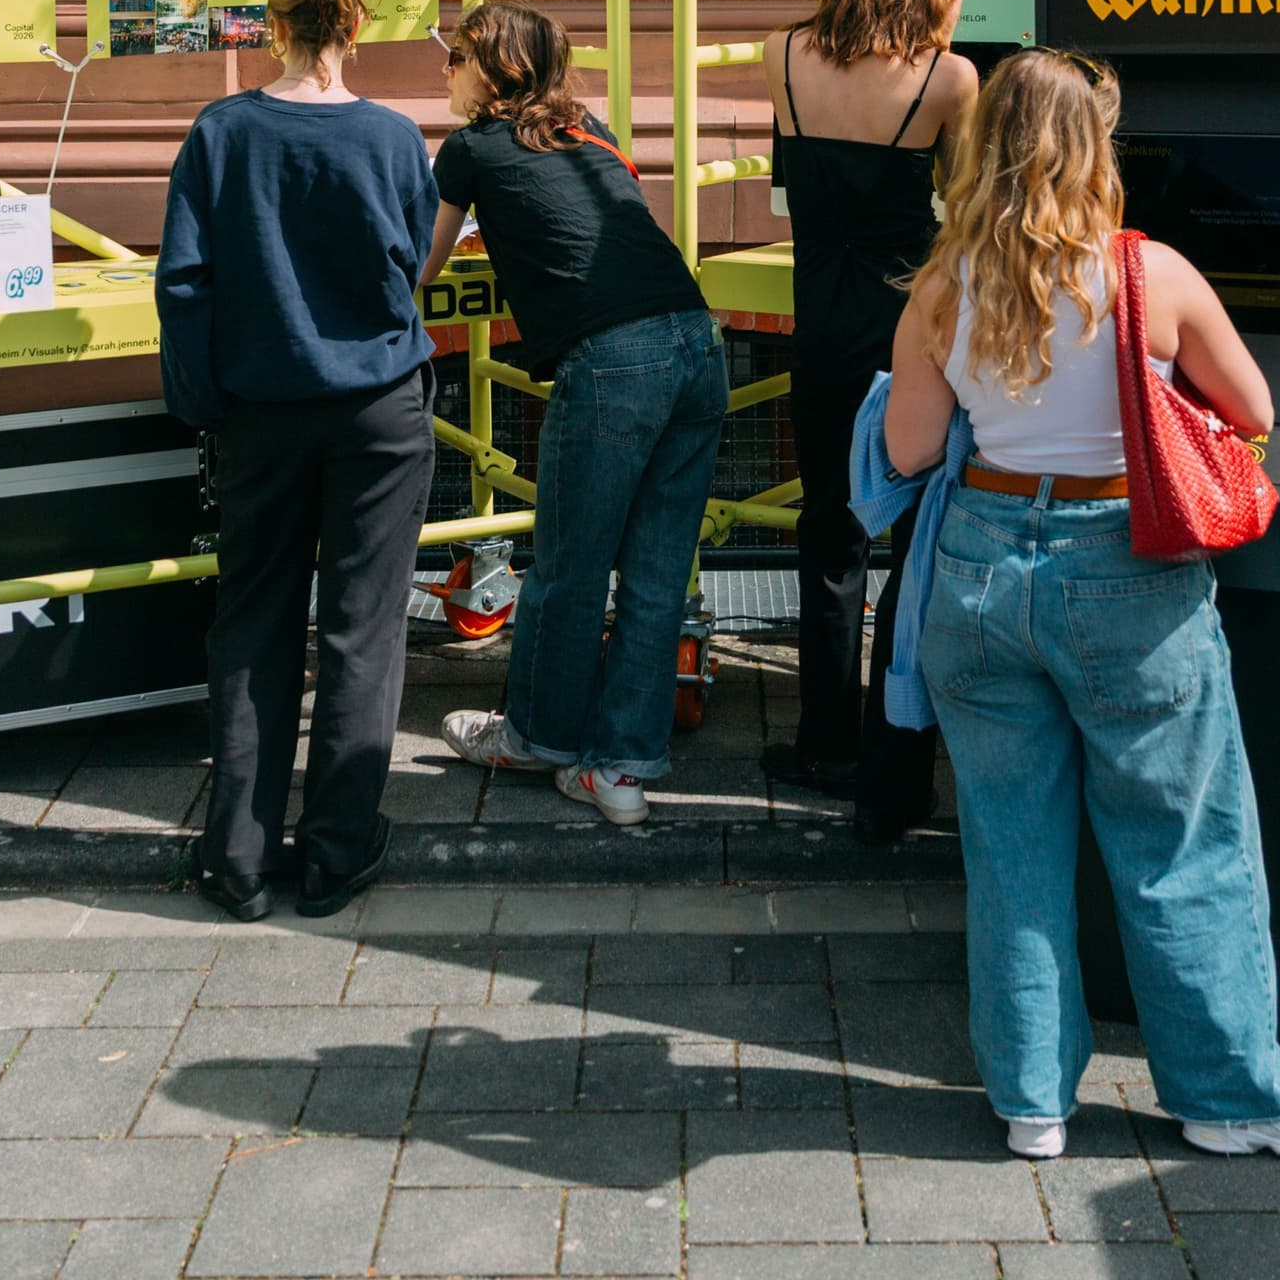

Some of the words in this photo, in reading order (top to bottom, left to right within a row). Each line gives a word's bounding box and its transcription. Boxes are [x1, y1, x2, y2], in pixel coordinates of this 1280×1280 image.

[4, 23, 34, 33] Capital
[13, 31, 34, 40] 2026
[28, 345, 64, 357] Visuals
[66, 345, 78, 355] by
[80, 340, 150, 353] @sarah.jennen
